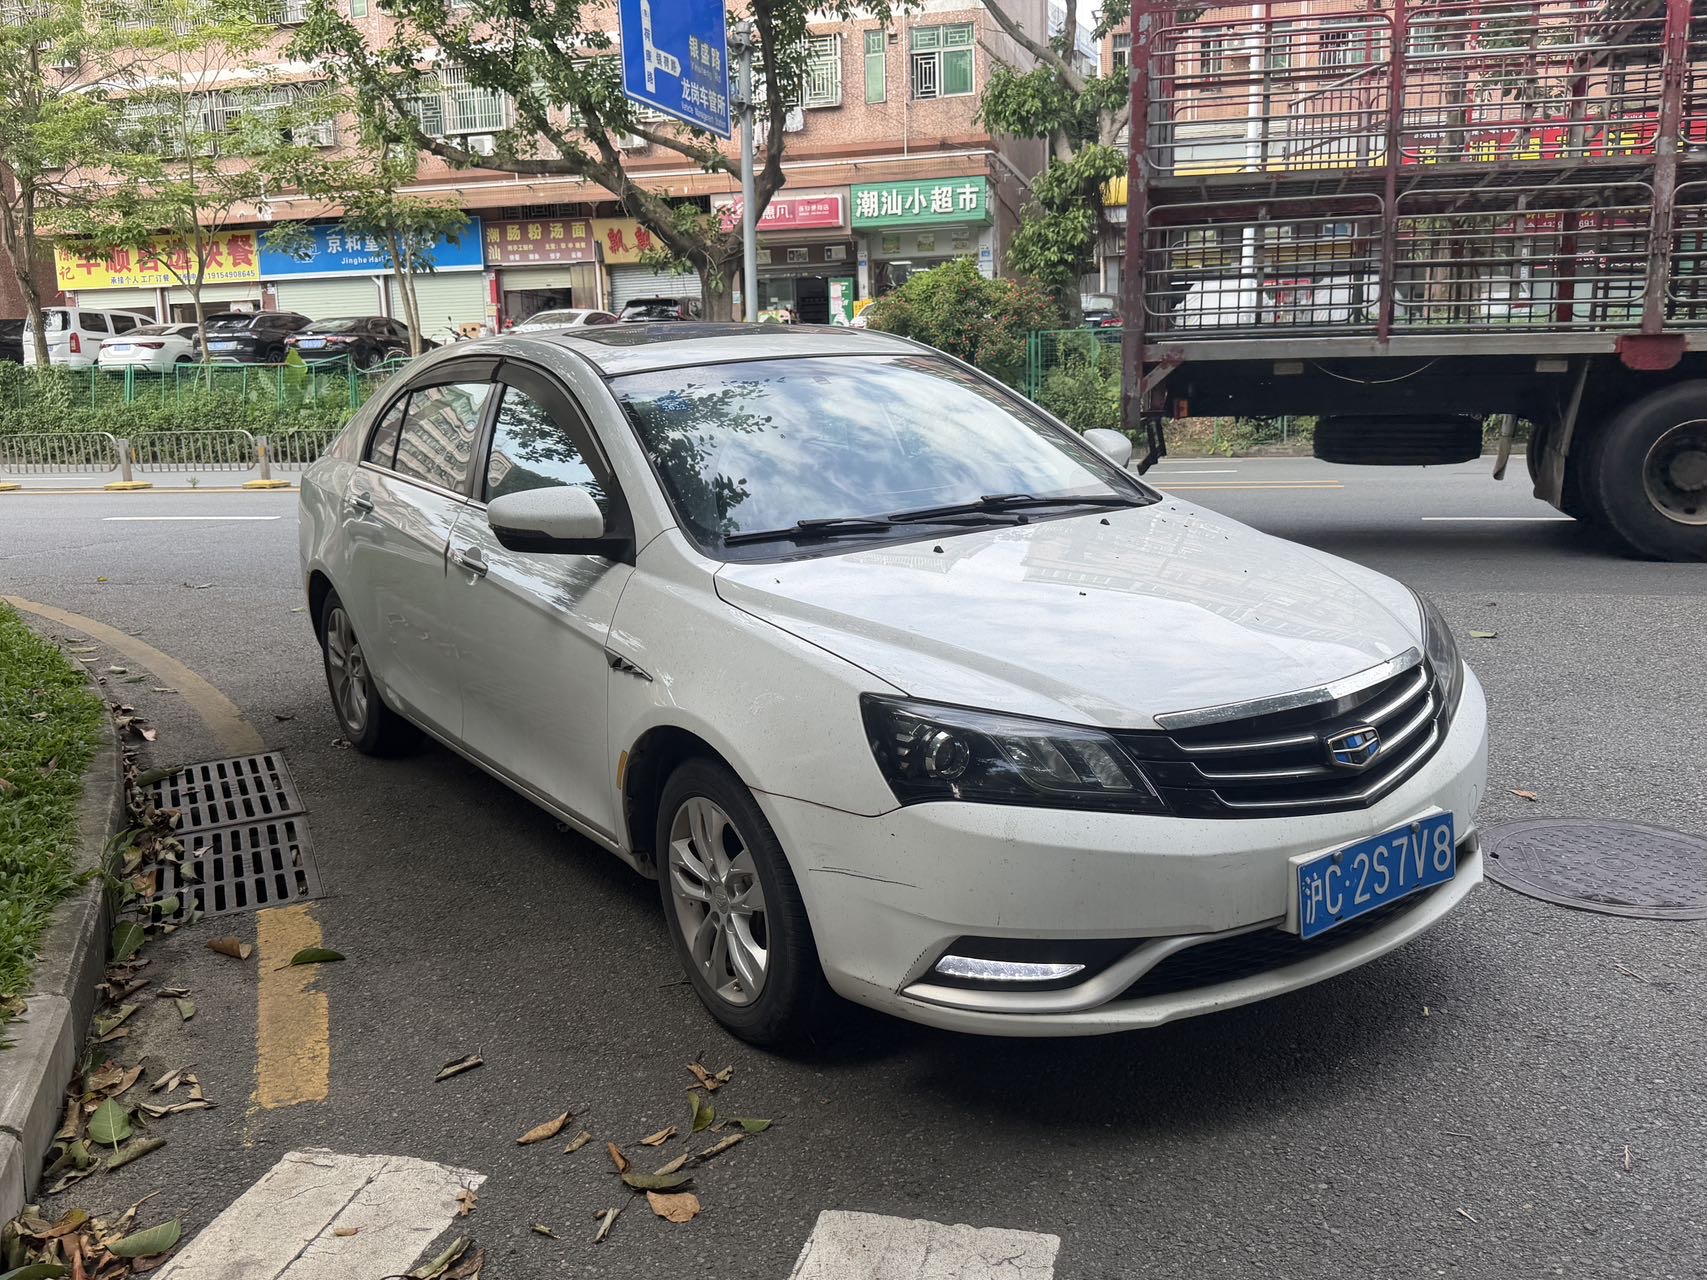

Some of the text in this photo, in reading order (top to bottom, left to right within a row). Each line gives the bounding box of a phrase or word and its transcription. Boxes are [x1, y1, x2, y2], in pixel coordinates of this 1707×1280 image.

[680, 77, 726, 117] 龙岗车管所
[855, 184, 979, 218] 潮汕小超市
[486, 227, 501, 260] 潮汕
[506, 222, 586, 241] 肠粉汤面
[341, 256, 368, 265] Jinghe
